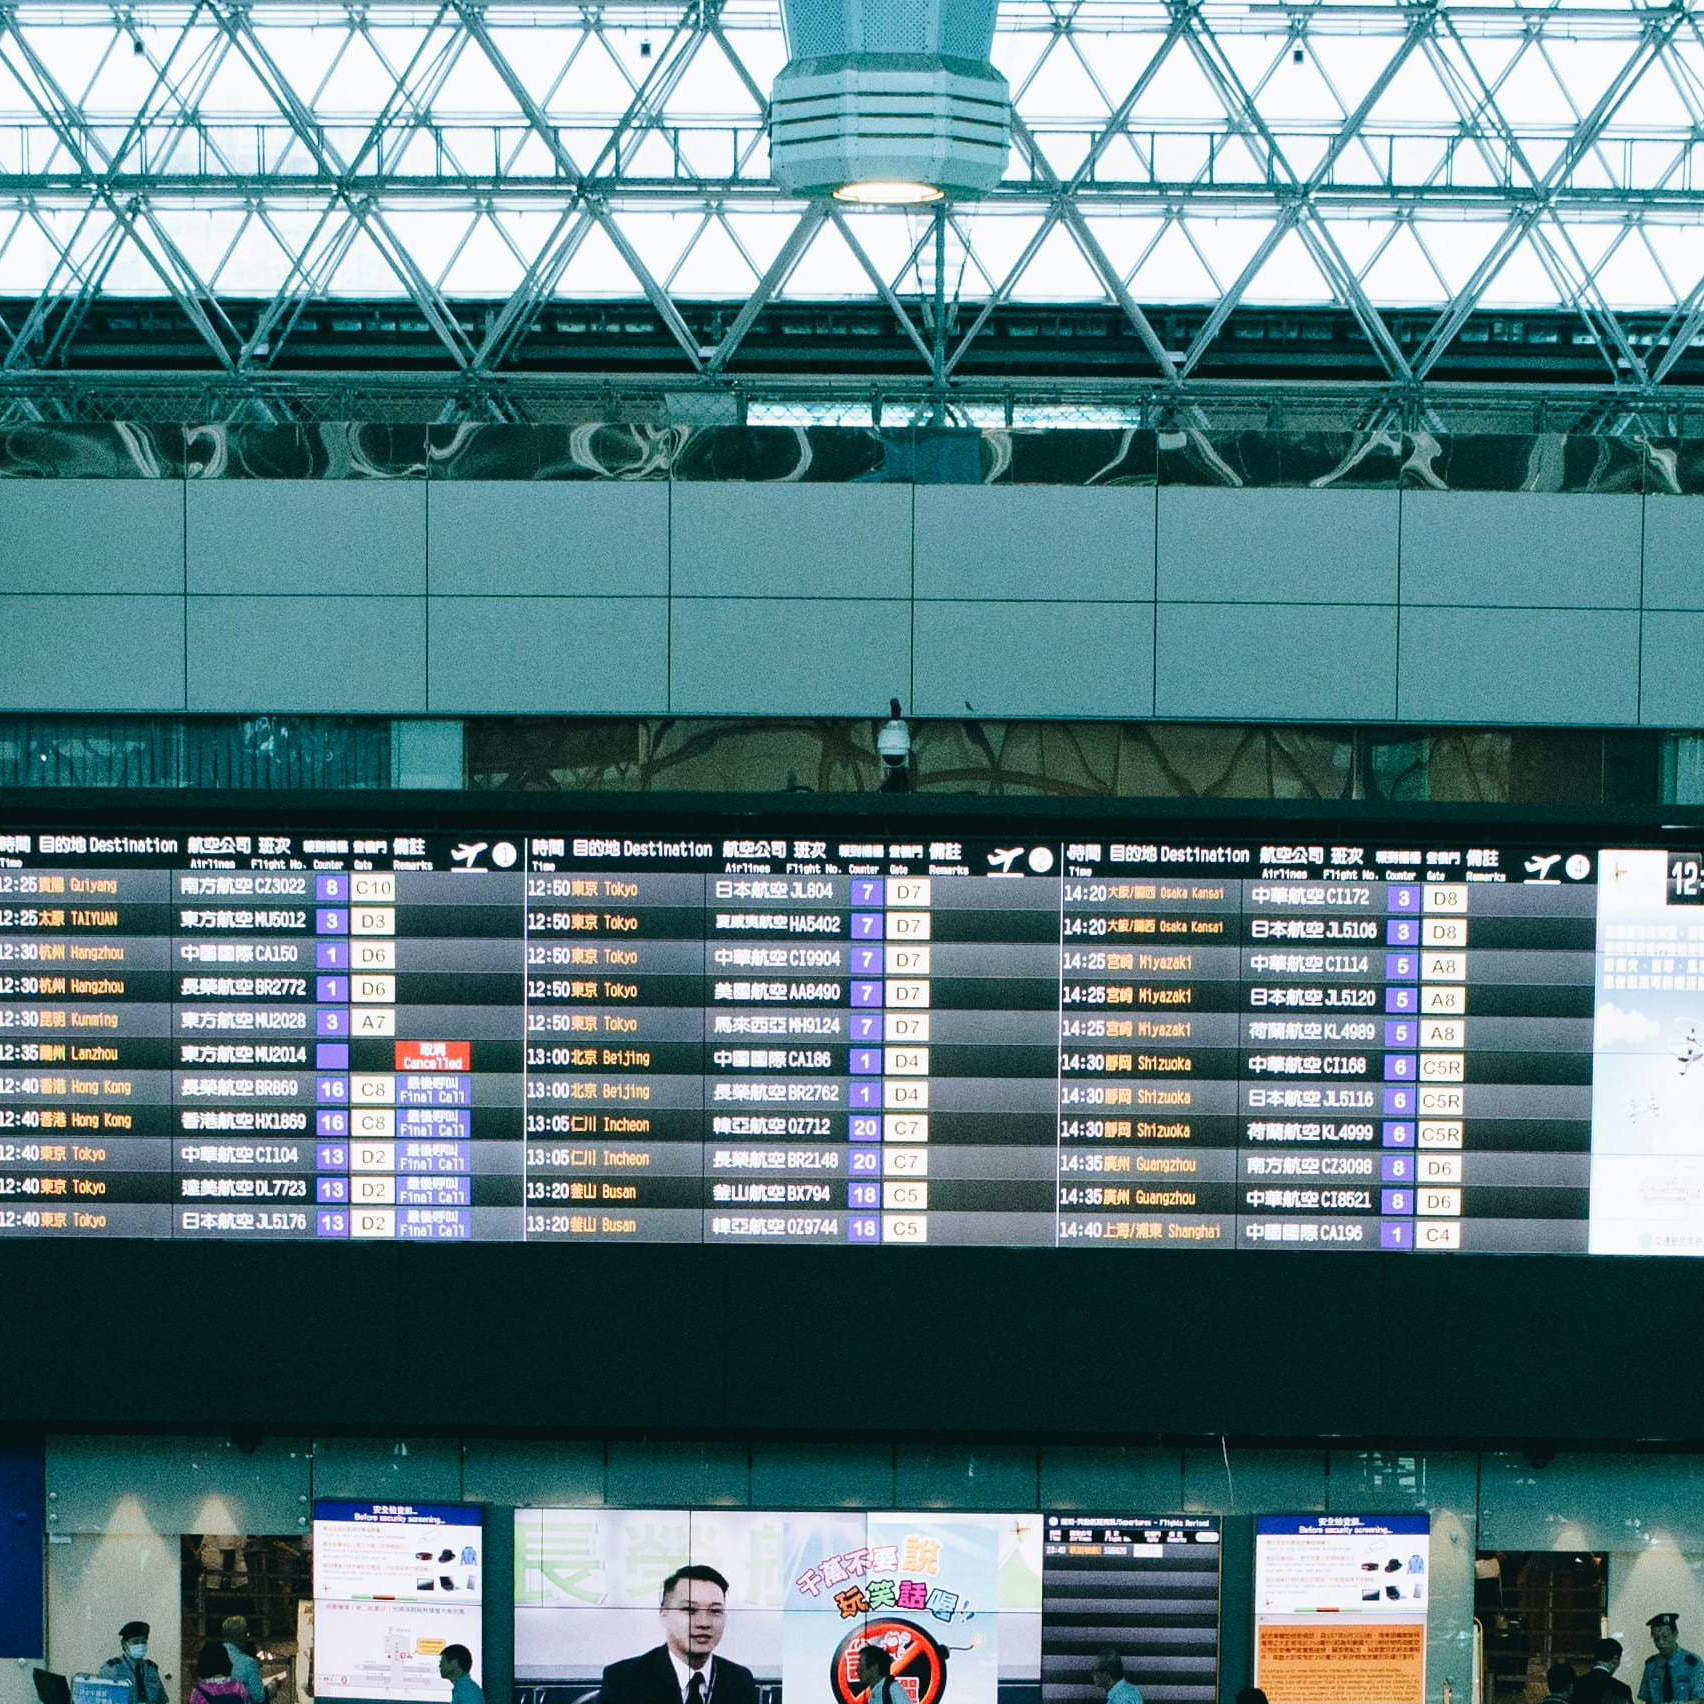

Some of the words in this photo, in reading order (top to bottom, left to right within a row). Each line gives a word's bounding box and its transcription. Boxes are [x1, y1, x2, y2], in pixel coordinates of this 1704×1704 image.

[39, 836, 87, 853] 目的地
[89, 837, 178, 853] Destination
[188, 837, 251, 854] 航空公司
[258, 837, 291, 855] 班次
[624, 840, 713, 857] Destination
[1161, 846, 1250, 863] Destination
[190, 859, 235, 870] Airlines
[251, 859, 286, 871] Flight
[290, 860, 307, 870] No.
[313, 859, 344, 870] Counter
[354, 859, 373, 870] Gate
[393, 860, 433, 871] Remarks
[528, 880, 570, 896] 12:50
[571, 880, 598, 897] 東京
[604, 881, 638, 898] Tokyo
[715, 881, 788, 899] 日本航空
[790, 881, 833, 899] JL804
[862, 884, 874, 899] 7
[897, 885, 920, 899] D7
[1064, 885, 1107, 901] 14:20
[1160, 887, 1188, 899] Osaka
[1192, 887, 1224, 899] Kansai
[1252, 887, 1324, 905] 中華航空
[1326, 888, 1370, 905] CI172
[1398, 891, 1410, 906] 3
[1434, 892, 1458, 905] D8
[38, 910, 65, 926] 太原
[70, 911, 118, 926] TAIYUAN
[180, 911, 253, 928] 東方航空
[255, 911, 306, 928] MU5012
[326, 914, 338, 928] 3
[362, 915, 386, 928] D3
[38, 944, 65, 961] 杭州
[70, 945, 124, 961] Hangzhou
[256, 945, 298, 962] CA150
[327, 947, 336, 962] 1
[362, 948, 386, 962] D6
[1063, 986, 1105, 1003] 14:25
[1138, 988, 1192, 1005] Miyazaki
[1250, 988, 1323, 1006] 日本航空
[1324, 990, 1376, 1006] JL5120
[1396, 992, 1408, 1006] 5
[1432, 993, 1455, 1006] A8
[71, 1046, 118, 1061] Lanzhou
[181, 1045, 254, 1063] 東方航空
[255, 1046, 307, 1063] MU2014
[403, 1057, 463, 1070] Cancelled
[527, 1048, 569, 1065] 13:00
[571, 1049, 597, 1066] 北京
[603, 1050, 650, 1067] Beijing
[788, 1051, 831, 1068] CA186
[860, 1054, 870, 1069] 1
[895, 1054, 919, 1068] D4
[1061, 1054, 1104, 1070] 14:30
[1137, 1055, 1192, 1071] Shizuoka
[1248, 1056, 1321, 1074] 中華航空
[1323, 1056, 1366, 1073] CI168
[1394, 1059, 1407, 1075] 6
[1423, 1060, 1461, 1075] C5R
[39, 1078, 66, 1095] 香港
[71, 1080, 99, 1095] Hong
[103, 1080, 132, 1095] Kong
[256, 1079, 298, 1097] BR869
[321, 1082, 344, 1096] 16
[361, 1083, 385, 1097] C8
[400, 1090, 433, 1103] Final
[438, 1090, 465, 1103] Call
[527, 1115, 569, 1132] 13:05
[570, 1115, 596, 1132] 仁川
[603, 1116, 650, 1132] Incheon
[854, 1120, 877, 1135] 20
[894, 1121, 918, 1135] C7
[527, 1183, 569, 1199] 13:20
[570, 1183, 596, 1199] 釜山
[602, 1184, 636, 1199] Busan
[713, 1184, 786, 1202] 釜山航空
[787, 1184, 830, 1201] BX794
[853, 1187, 876, 1202] 18
[894, 1188, 918, 1202] C5
[1060, 1221, 1102, 1238] 14:40
[1103, 1222, 1162, 1238] 上海/浦東
[1168, 1223, 1221, 1240] Shanghai
[1320, 1224, 1363, 1241] CA196
[1392, 1227, 1402, 1242] 1
[1426, 1228, 1450, 1242] C4
[796, 1534, 942, 1598] 千萬不要說
